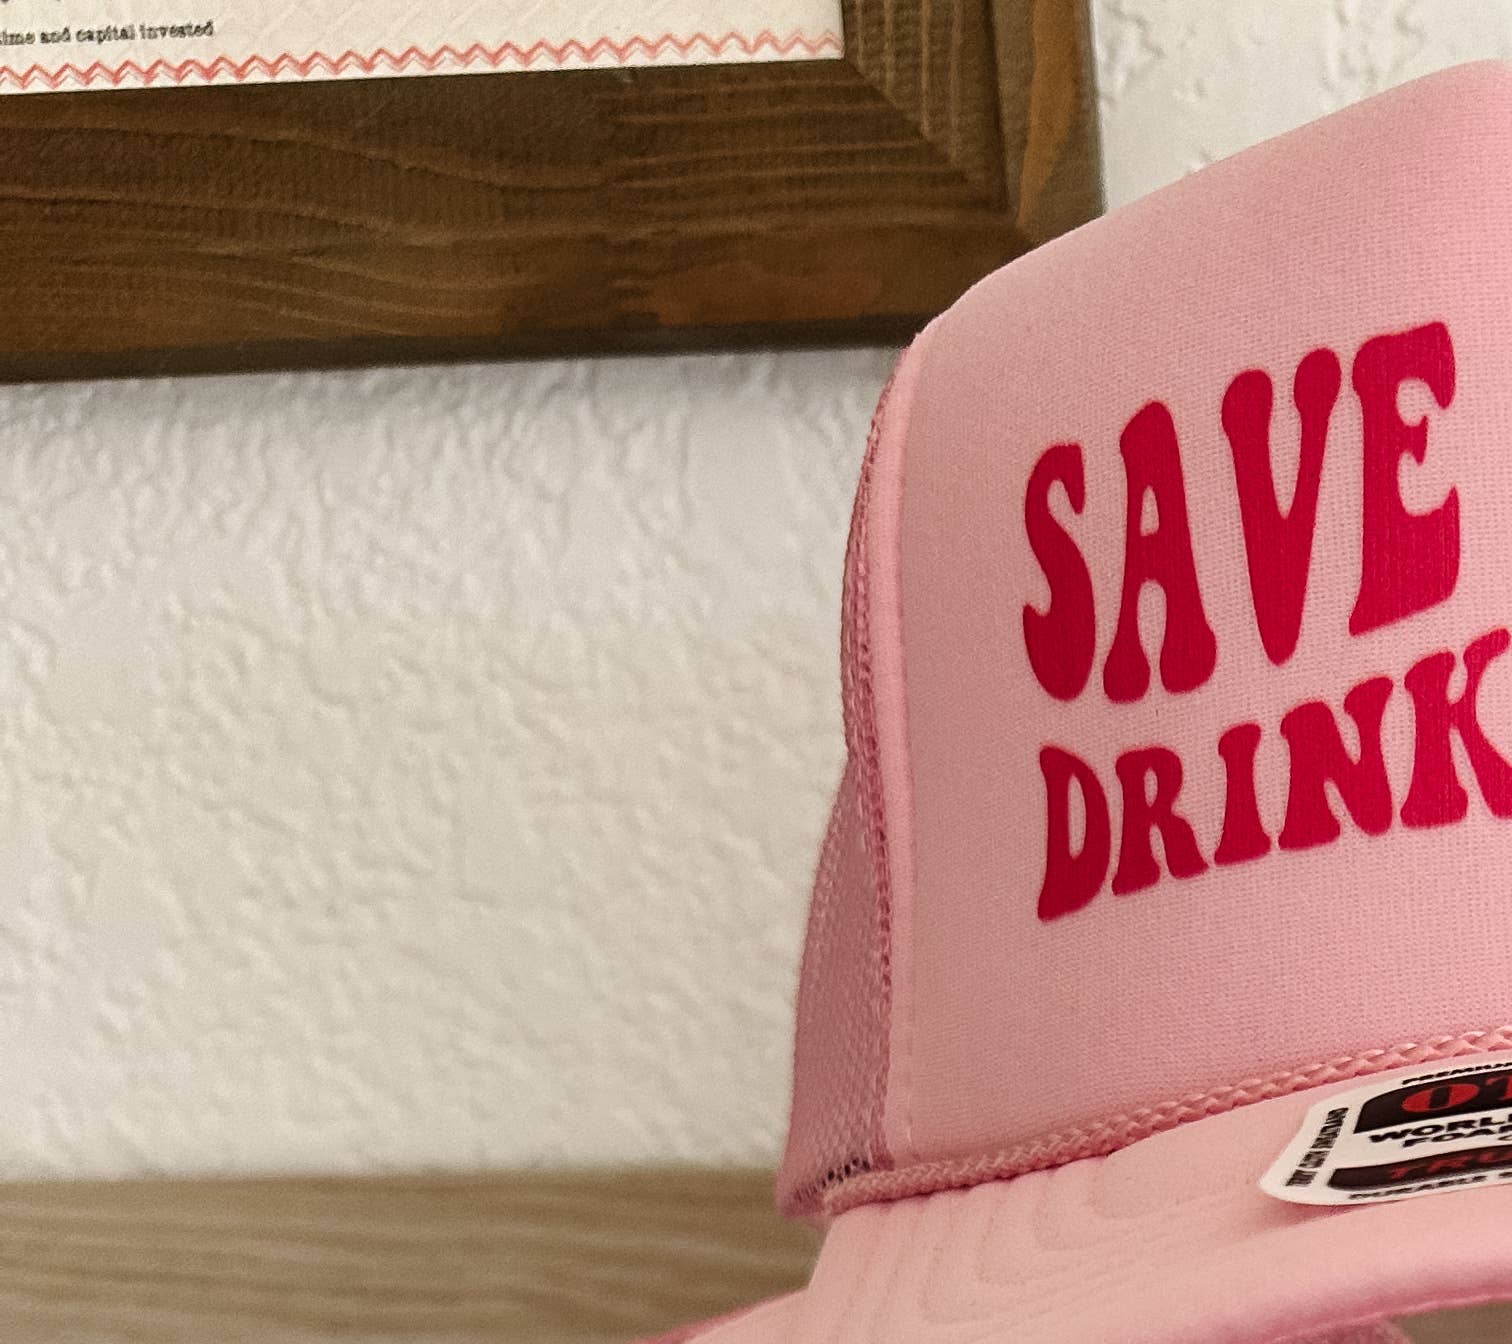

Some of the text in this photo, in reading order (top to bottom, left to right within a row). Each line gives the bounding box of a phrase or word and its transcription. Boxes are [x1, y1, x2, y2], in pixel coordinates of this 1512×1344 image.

[40, 26, 71, 43] and
[76, 25, 135, 45] capital
[139, 19, 213, 40] invested
[1022, 321, 1460, 703] SAVE
